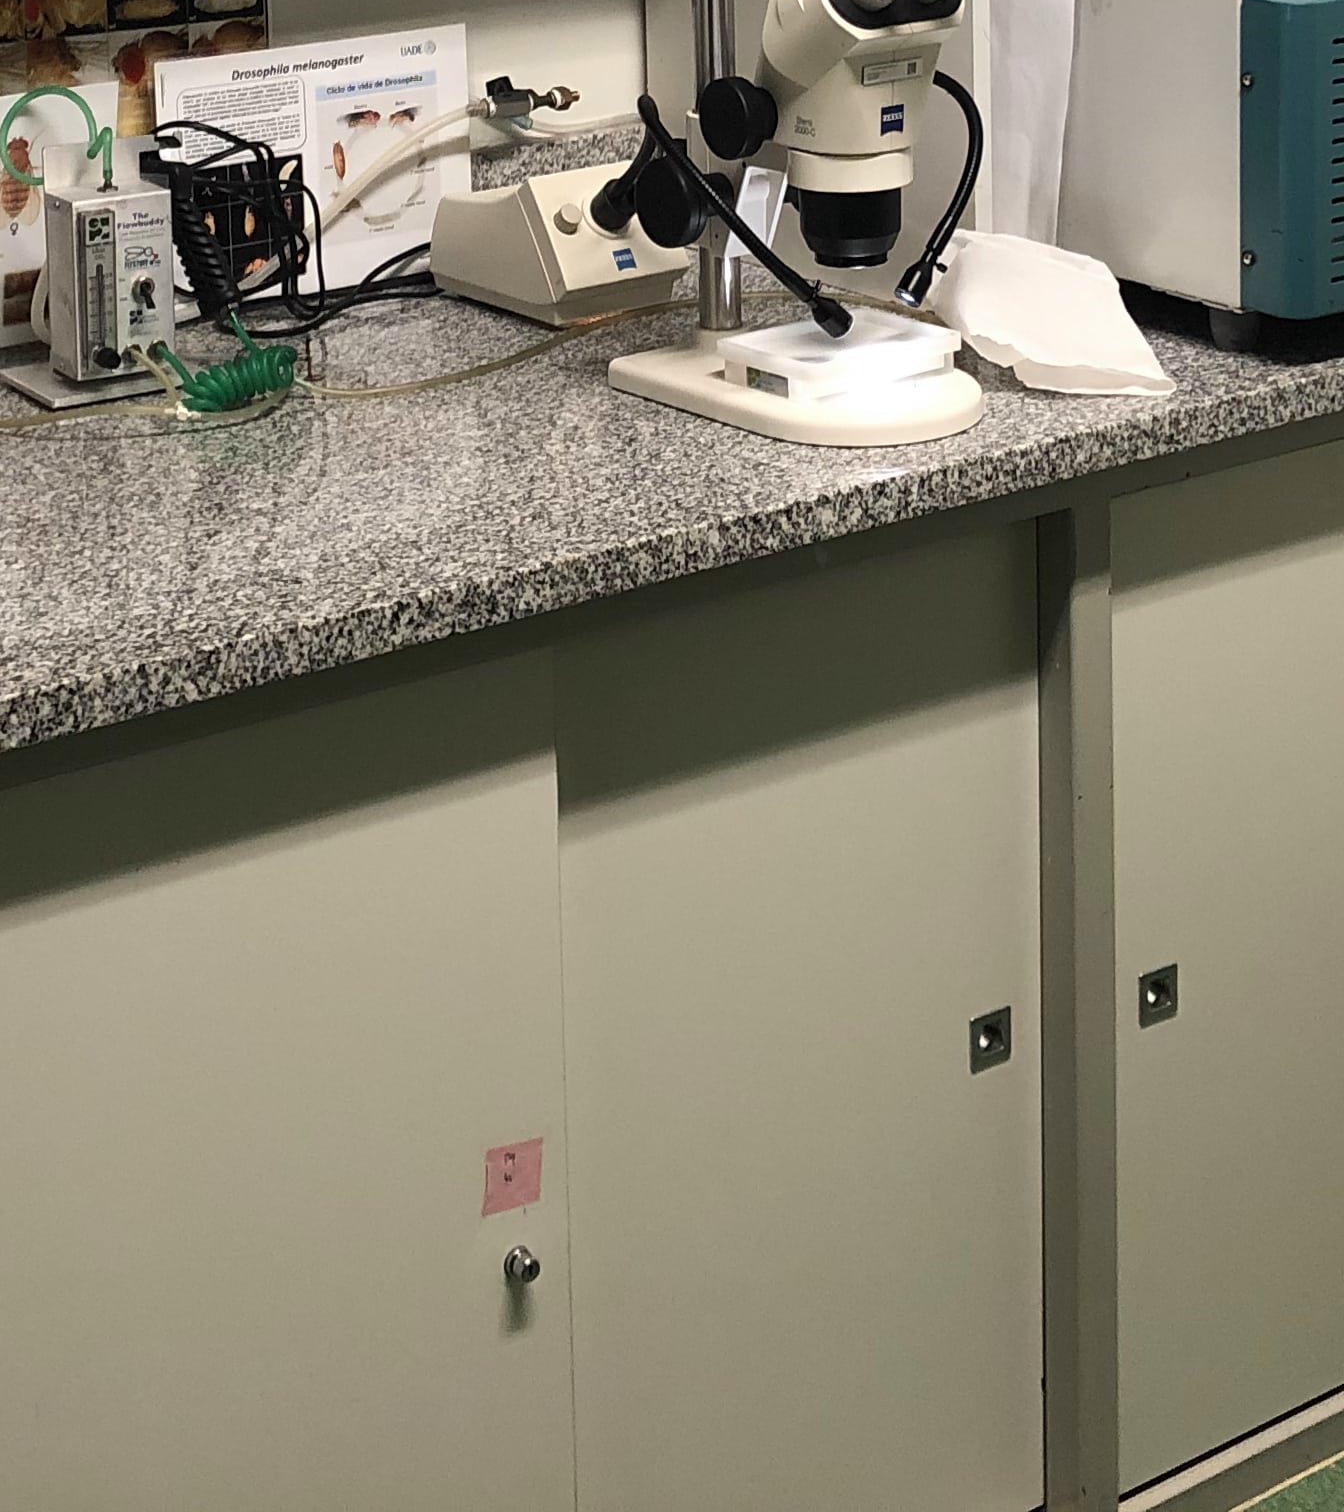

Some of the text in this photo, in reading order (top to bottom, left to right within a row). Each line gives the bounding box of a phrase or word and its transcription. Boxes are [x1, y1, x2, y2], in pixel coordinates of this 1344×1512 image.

[401, 43, 422, 56] UADE
[231, 53, 365, 81] Drosophila melanogaster
[326, 84, 345, 95] Ciclo
[347, 82, 356, 92] de
[374, 79, 384, 89] de
[385, 74, 423, 88] Drosophila
